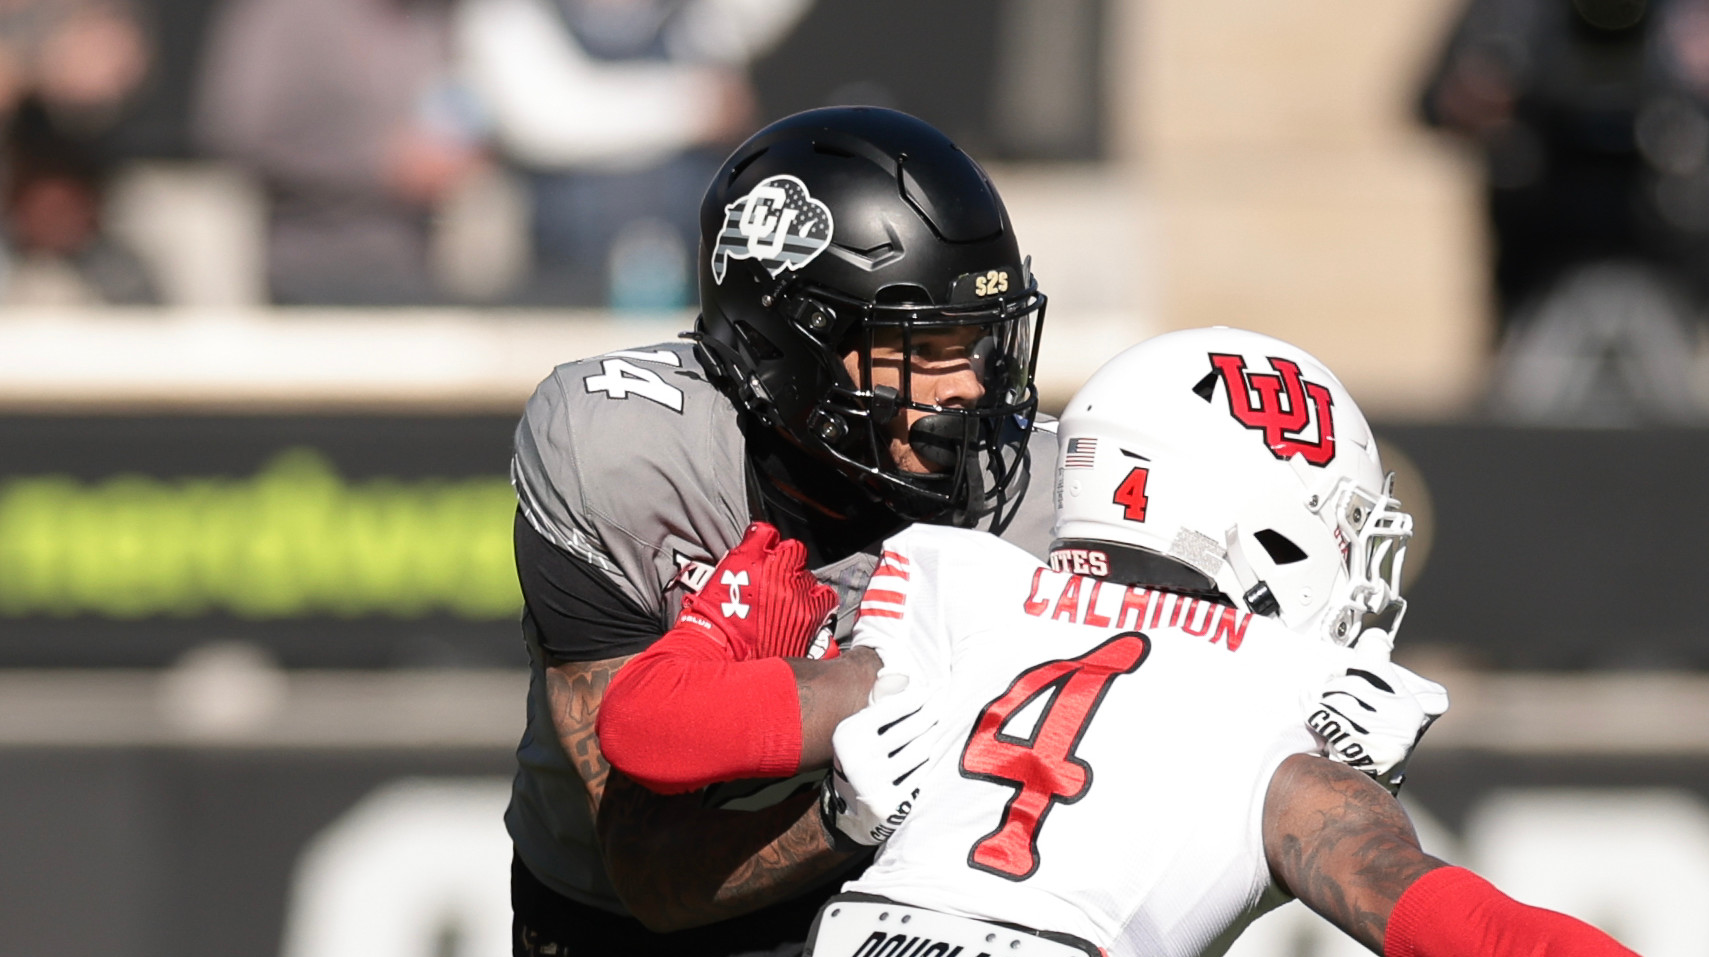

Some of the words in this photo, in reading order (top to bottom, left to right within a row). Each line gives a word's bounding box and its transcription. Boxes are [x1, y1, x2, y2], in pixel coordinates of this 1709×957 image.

[1112, 466, 1150, 524] 4
[1022, 567, 1254, 652] CALHOUN
[958, 630, 1152, 882] 4
